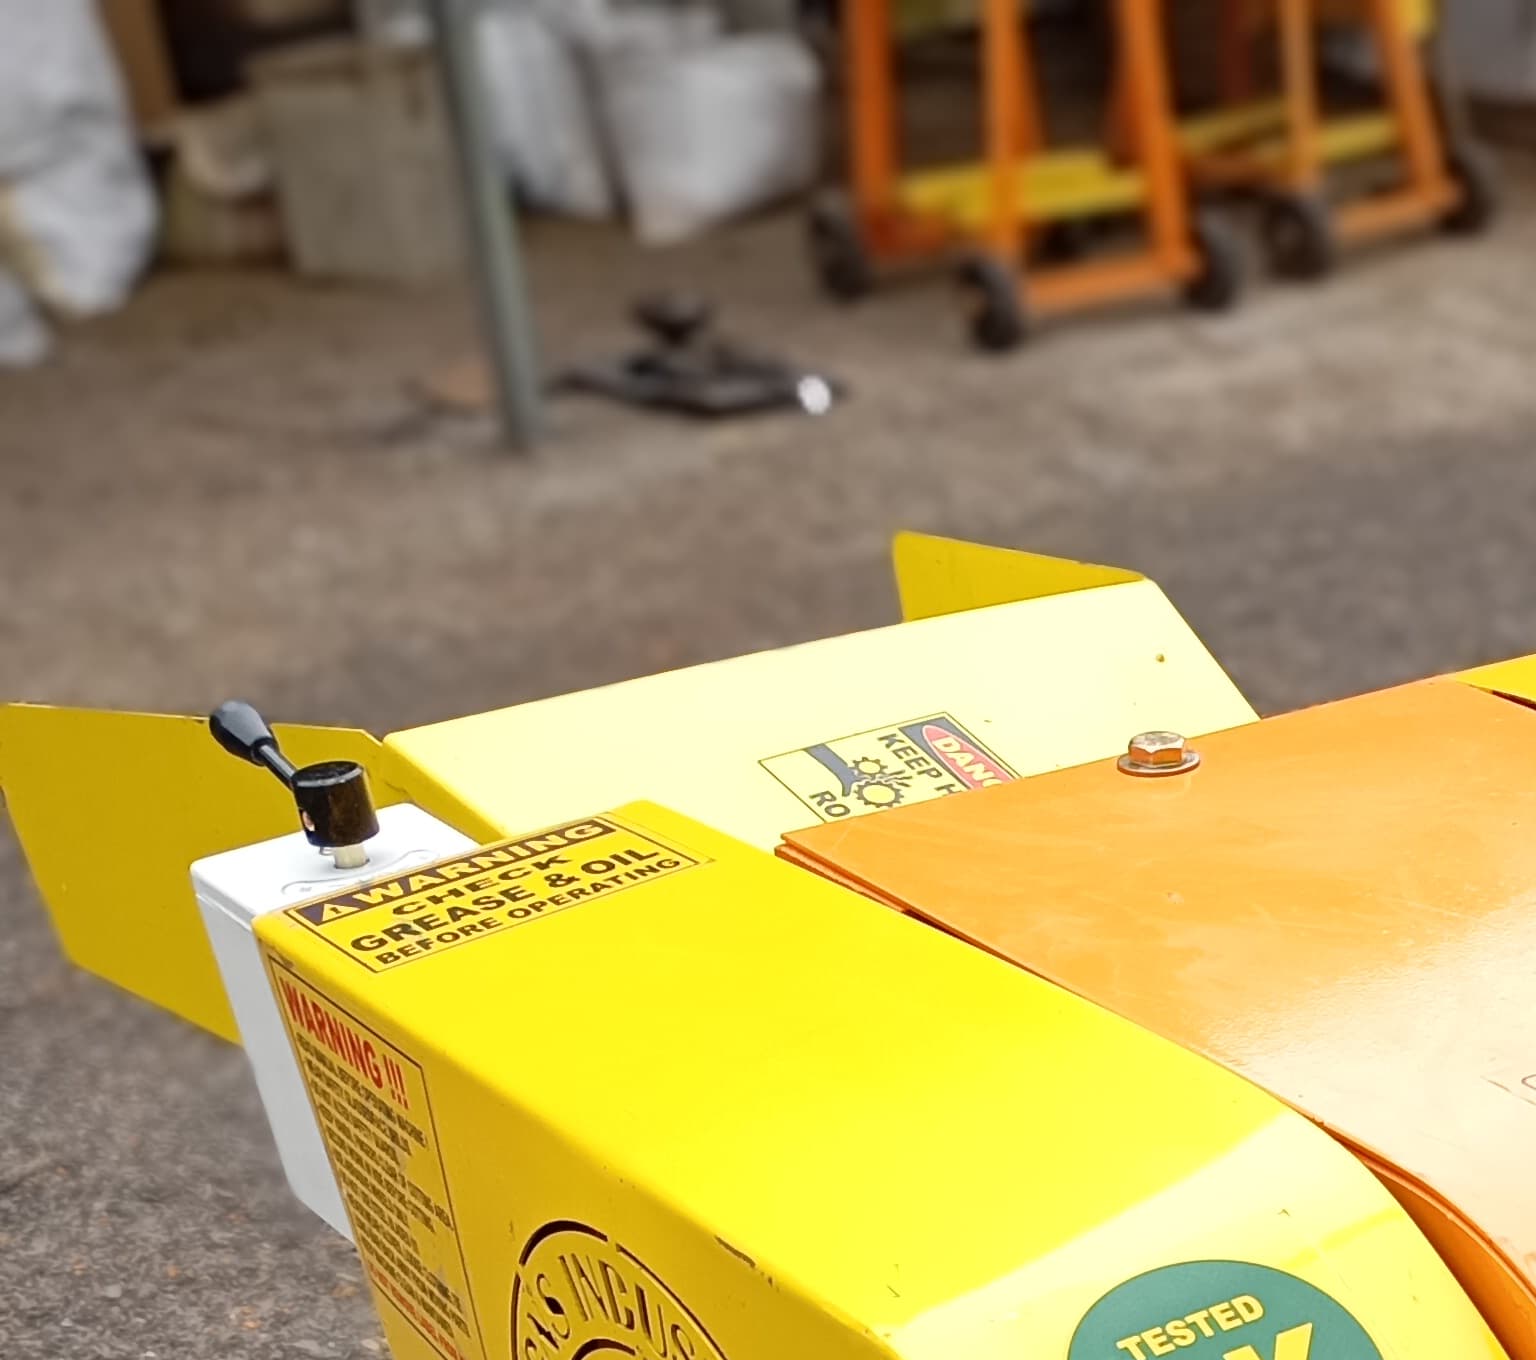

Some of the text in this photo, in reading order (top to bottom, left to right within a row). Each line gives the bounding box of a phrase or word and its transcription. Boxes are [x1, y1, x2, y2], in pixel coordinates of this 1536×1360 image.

[877, 732, 943, 780] KEEP
[350, 847, 660, 952] GREASE & OIL
[359, 823, 605, 903] WARNING
[391, 854, 571, 916] CHECK
[375, 857, 682, 965] BEFORE OPERATING
[279, 976, 384, 1090] WARNING
